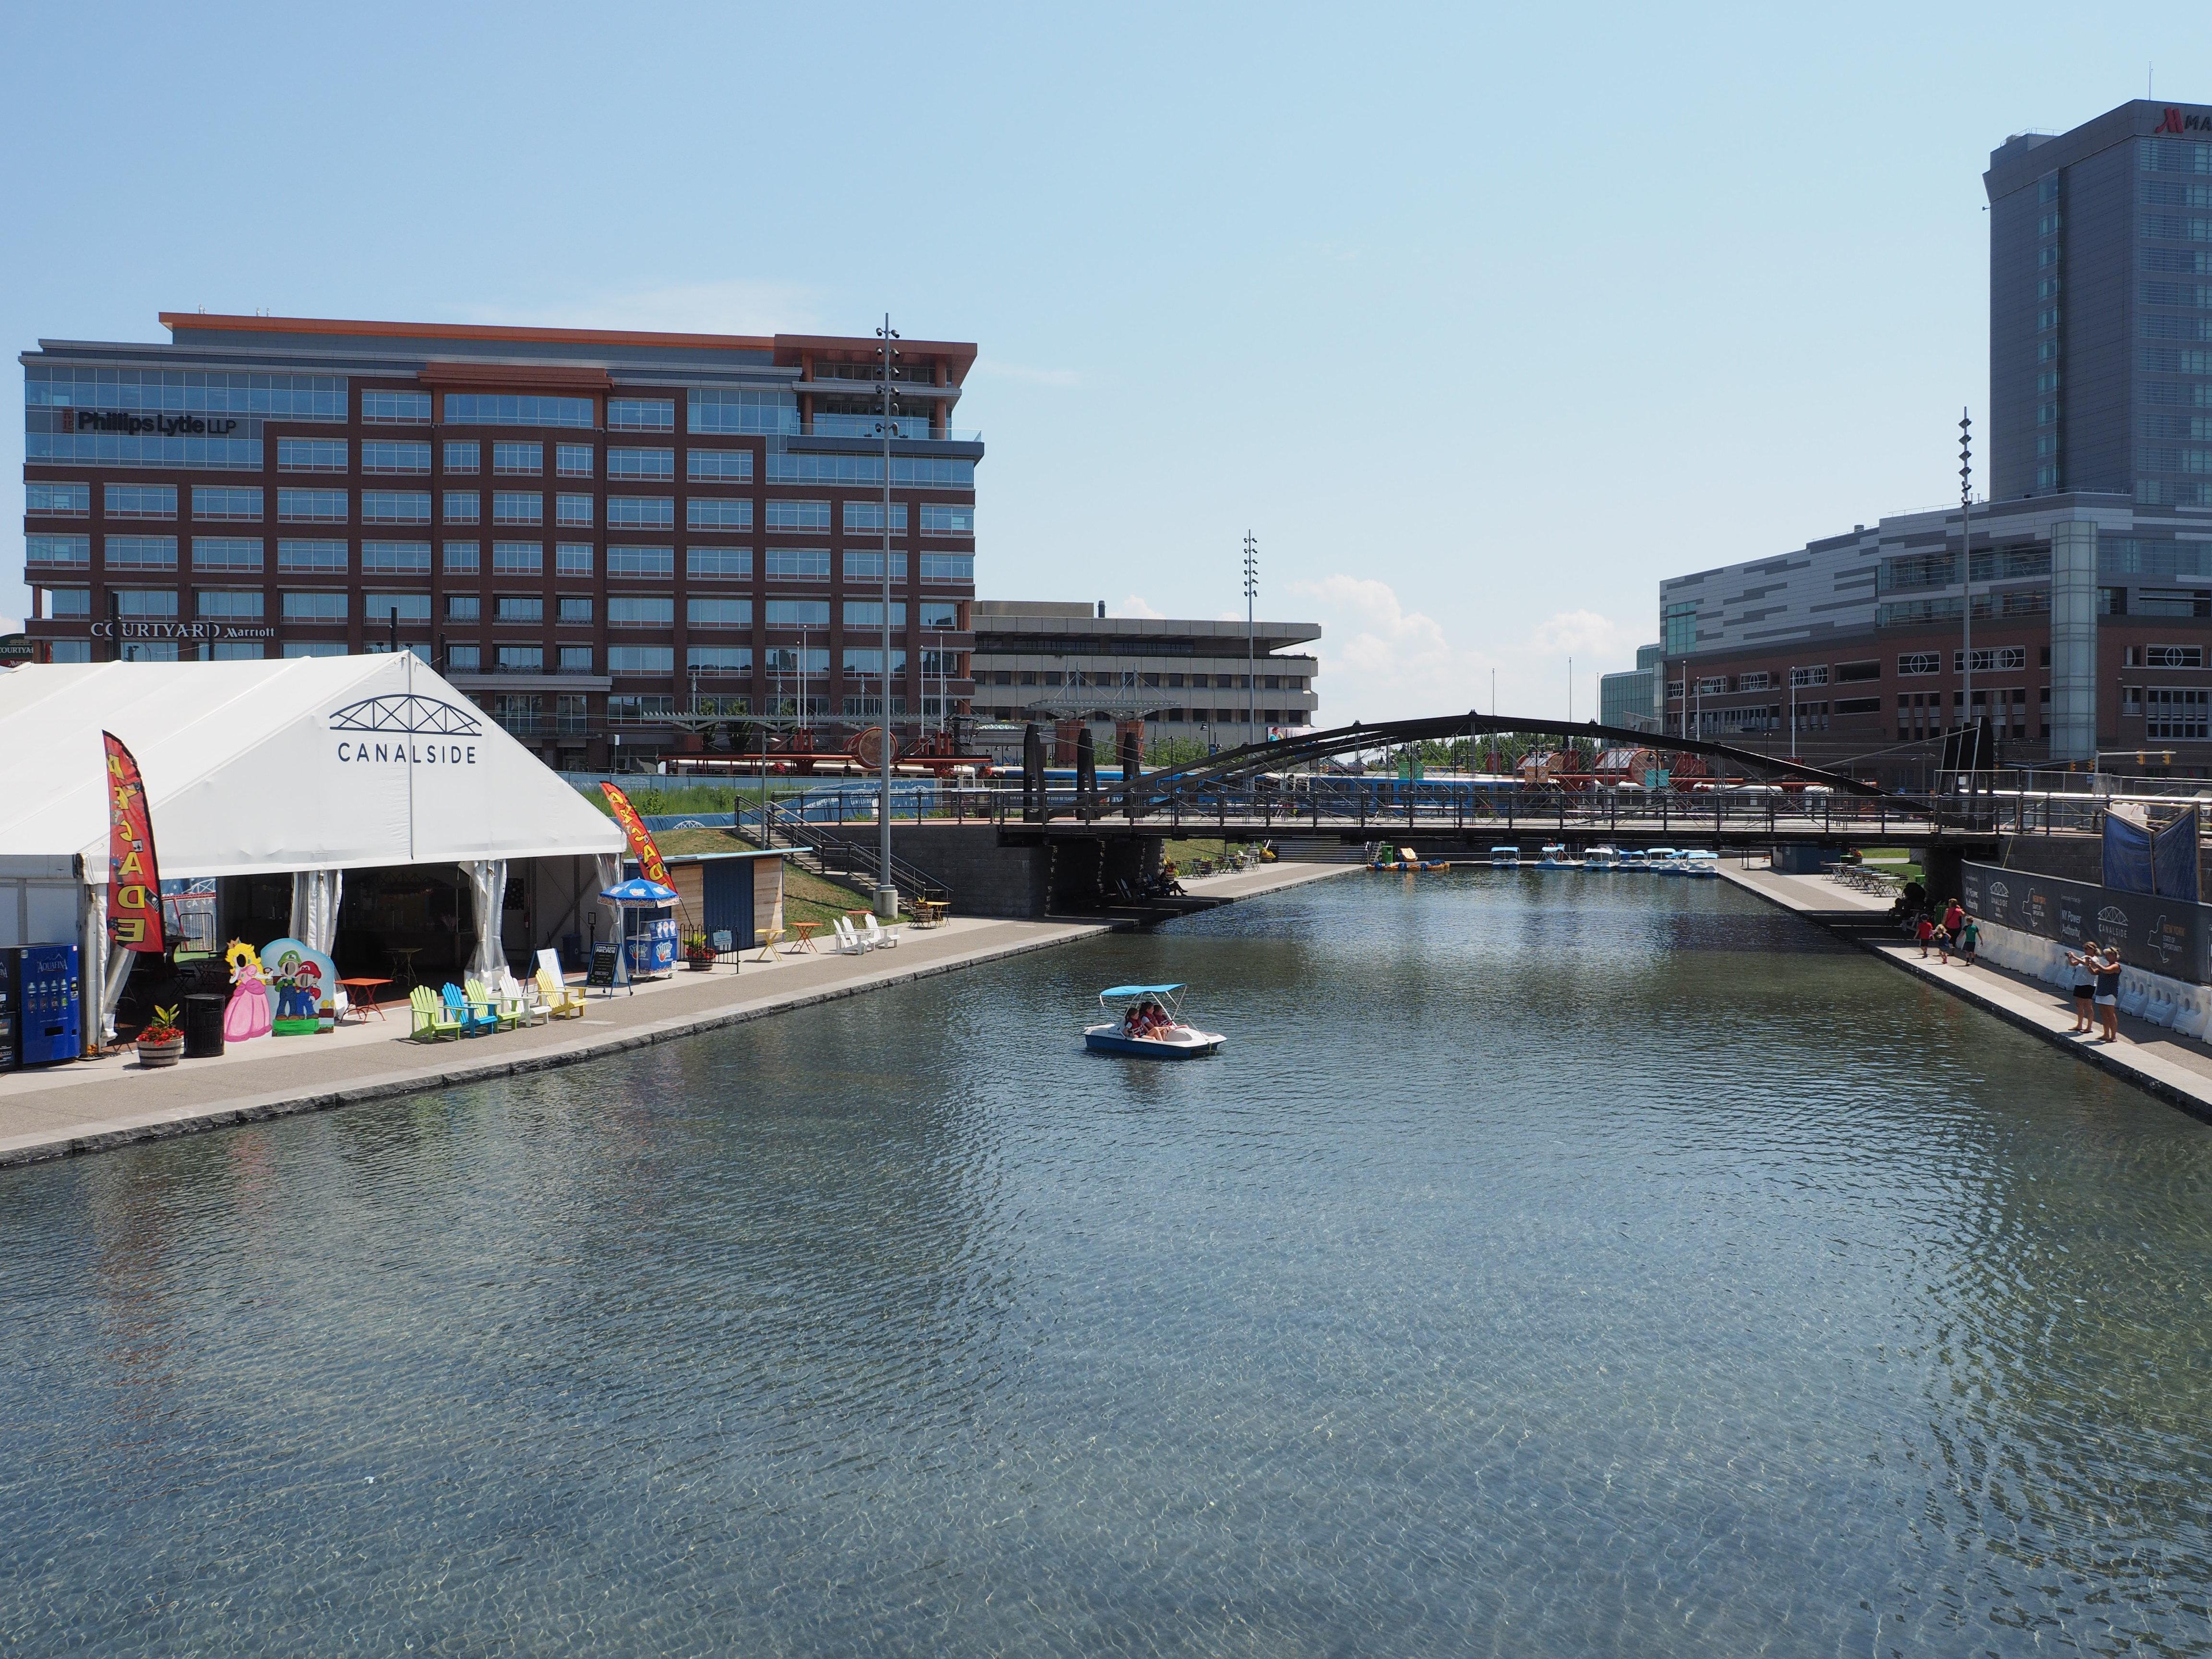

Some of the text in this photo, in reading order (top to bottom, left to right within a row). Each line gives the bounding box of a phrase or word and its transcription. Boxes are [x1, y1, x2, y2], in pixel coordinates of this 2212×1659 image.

[78, 411, 154, 435] Phillips
[157, 414, 204, 436] Lytle
[208, 420, 236, 433] LLP
[224, 627, 275, 638] Marriott
[338, 742, 476, 764] CANALSIDE
[2068, 911, 2081, 924] Power
[2099, 924, 2128, 938] CANALSIDE
